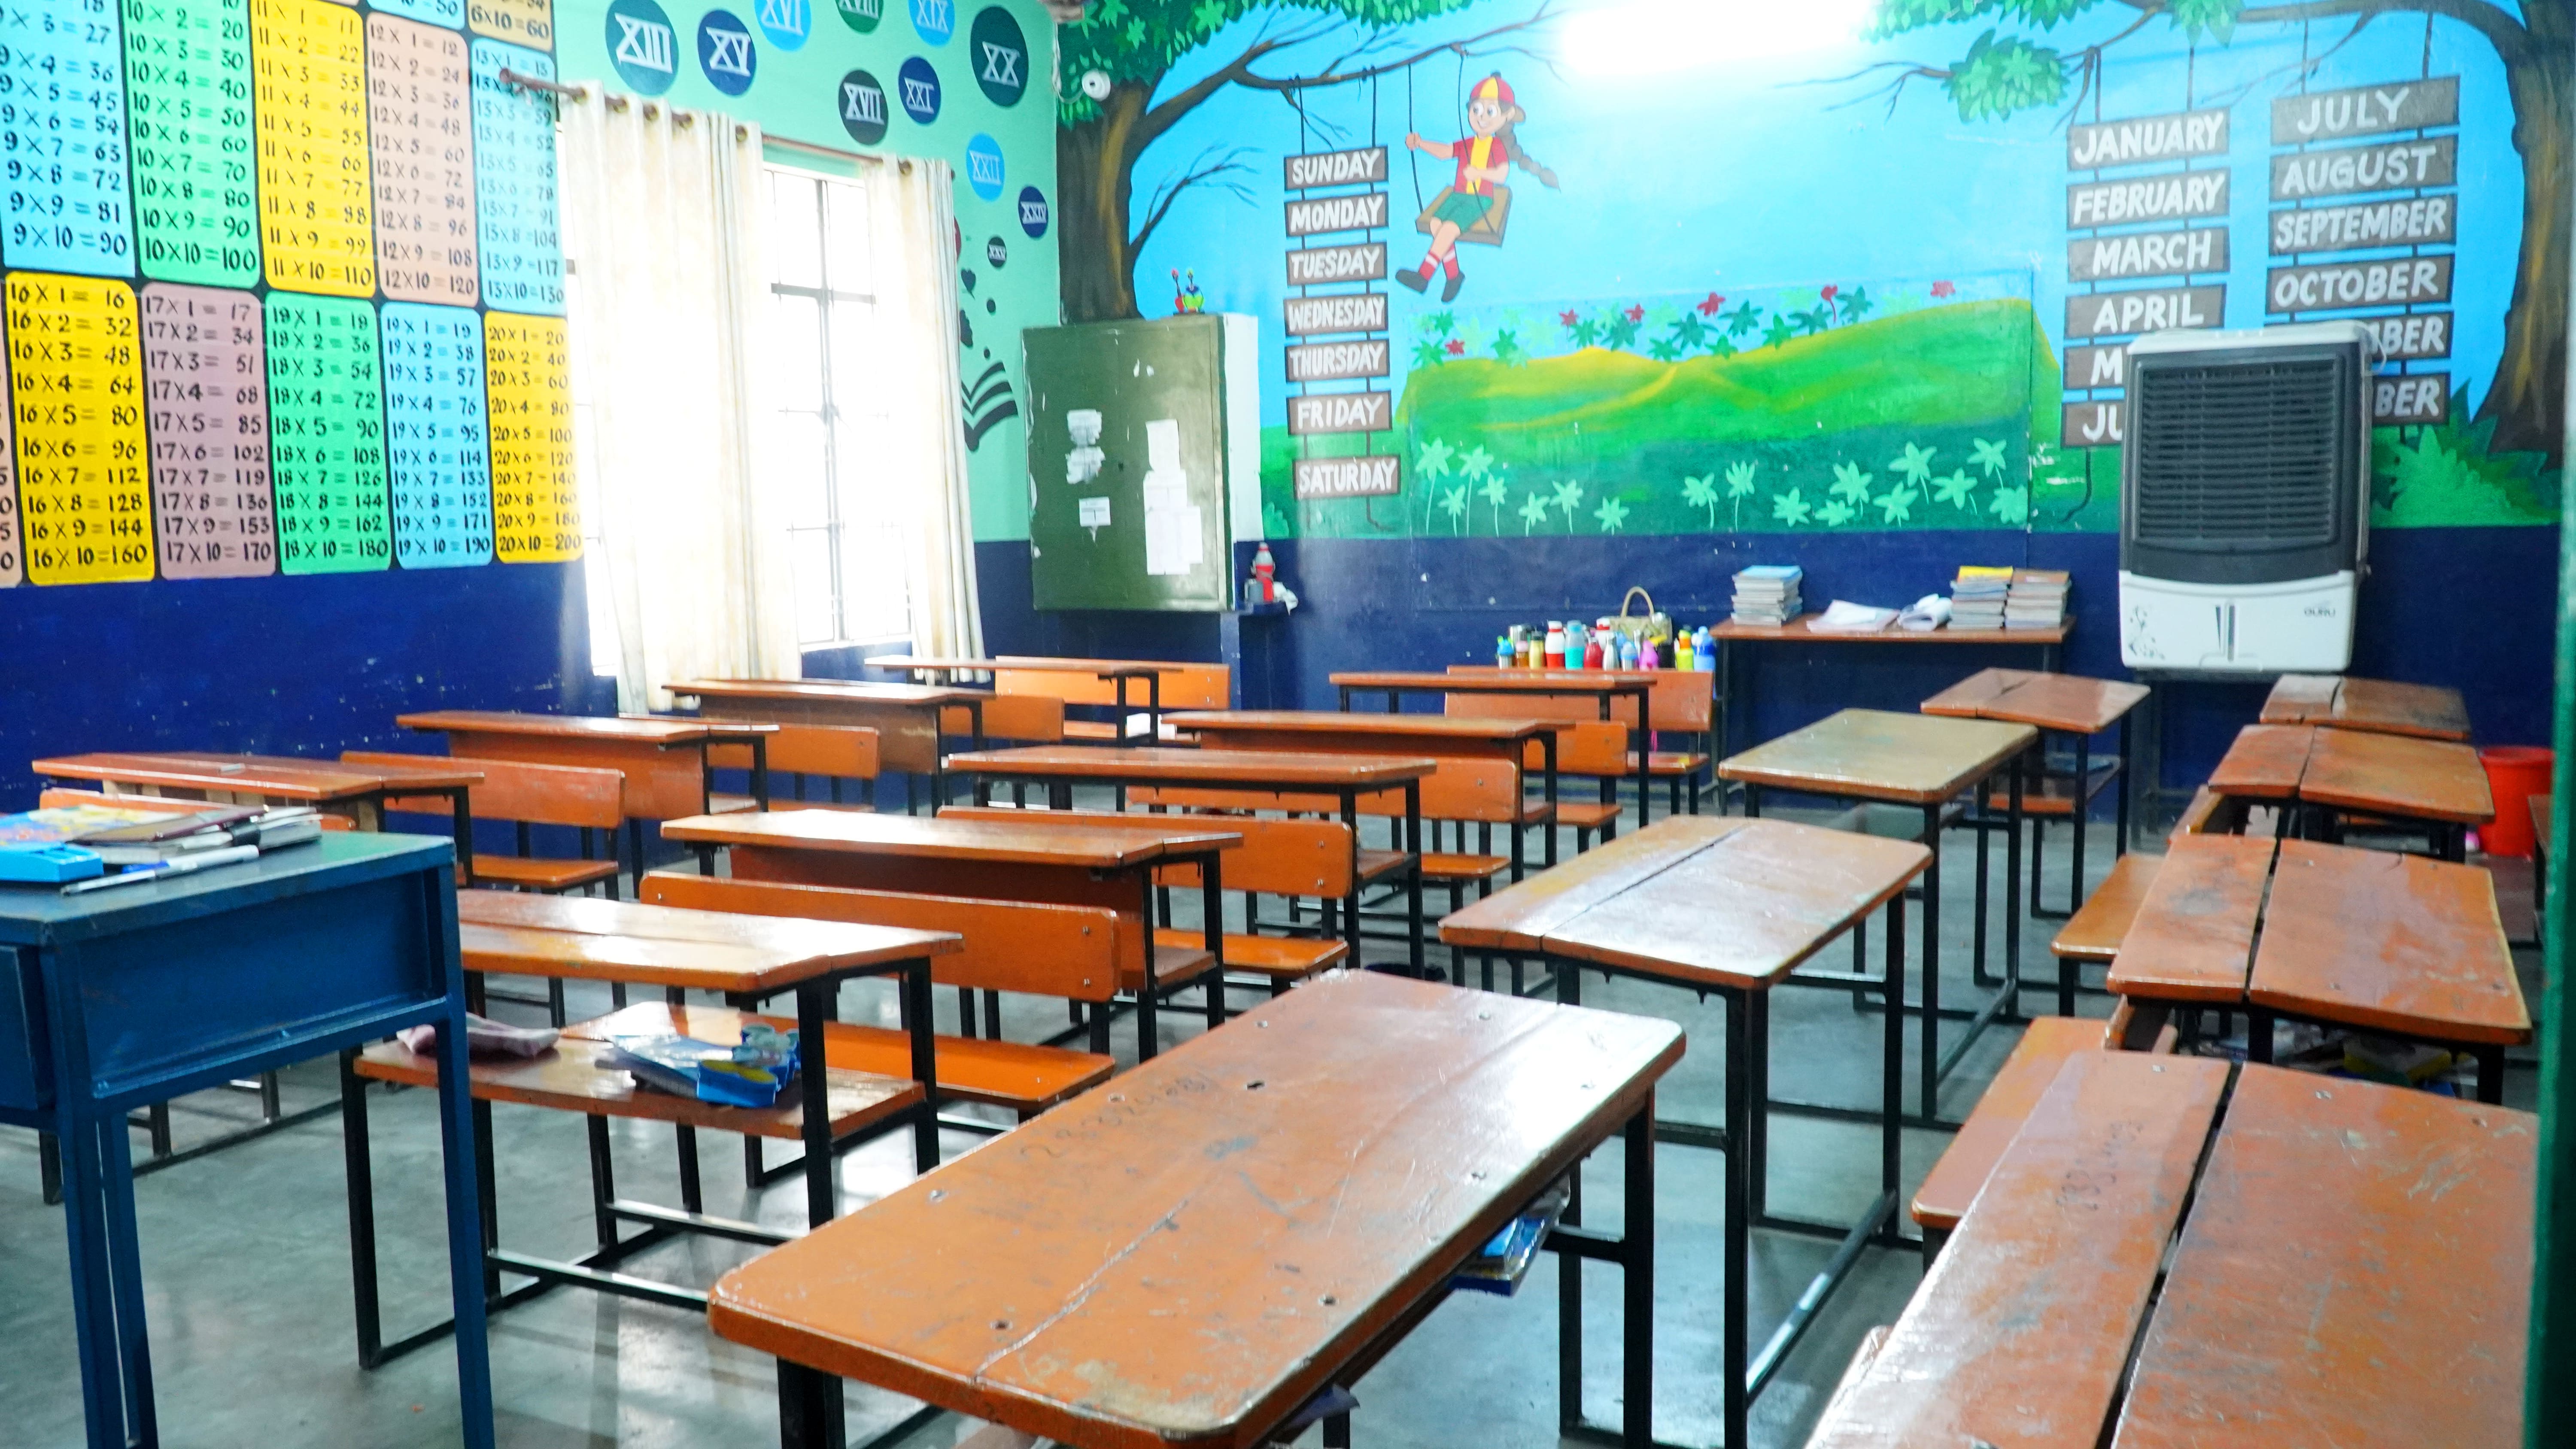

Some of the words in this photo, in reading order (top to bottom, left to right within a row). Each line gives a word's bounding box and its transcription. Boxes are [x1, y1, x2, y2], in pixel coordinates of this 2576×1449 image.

[615, 12, 672, 74] XIII
[706, 27, 750, 76] XV
[132, 61, 149, 82] 10
[175, 71, 187, 87] 4
[220, 79, 245, 98] 40
[982, 41, 1020, 88] XX
[843, 82, 884, 125] XVII
[904, 77, 934, 113] XXI
[2297, 87, 2409, 135] JULY
[2, 104, 15, 123] 9
[49, 110, 60, 130] 6
[96, 116, 118, 135] 54
[2074, 112, 2224, 165] JANUARY
[8, 160, 21, 179] 9
[51, 165, 61, 184] 8
[94, 170, 119, 191] 72
[969, 150, 1001, 185] XXII
[1292, 149, 1380, 185] SUNDAY
[2282, 144, 2436, 194] AUGUST
[141, 175, 156, 195] 10
[183, 182, 192, 198] 8
[225, 190, 249, 206] 80
[2074, 173, 2226, 225] FEBRUARY
[1290, 195, 1384, 233] MONDAY
[2275, 197, 2446, 250] SEPTEMBER
[14, 223, 26, 245] 9
[56, 226, 73, 248] 10
[100, 232, 126, 255] 90
[2093, 230, 2211, 275] MARCH
[1291, 246, 1380, 279] TUESDAY
[2275, 261, 2439, 307] OCTOBER
[1289, 296, 1385, 332] WEDNESDAY
[2093, 292, 2203, 333] APRIL
[149, 322, 166, 338] 17
[186, 324, 197, 342] 2
[233, 327, 253, 345] 34
[273, 330, 288, 348] 18
[314, 334, 322, 349] 2
[352, 336, 370, 353] 36
[1289, 343, 1385, 378] THURSDAY
[392, 394, 404, 408] 19
[423, 397, 432, 411] 4
[459, 397, 476, 415] 76
[1297, 395, 1382, 429] FRIDAY
[157, 443, 176, 460] 17
[195, 446, 206, 460] 6
[234, 445, 264, 462] 102
[277, 446, 293, 462] 18
[316, 450, 325, 463] 6
[355, 448, 379, 464] 108
[1299, 458, 1397, 494] SATURDAY
[395, 494, 407, 509] 19
[431, 494, 439, 508] 8
[463, 493, 486, 507] 152
[165, 517, 183, 535] 17
[204, 518, 215, 534] 9
[240, 517, 269, 535] 153
[282, 516, 296, 534] 18
[320, 516, 329, 530] 9
[357, 515, 382, 532] 162
